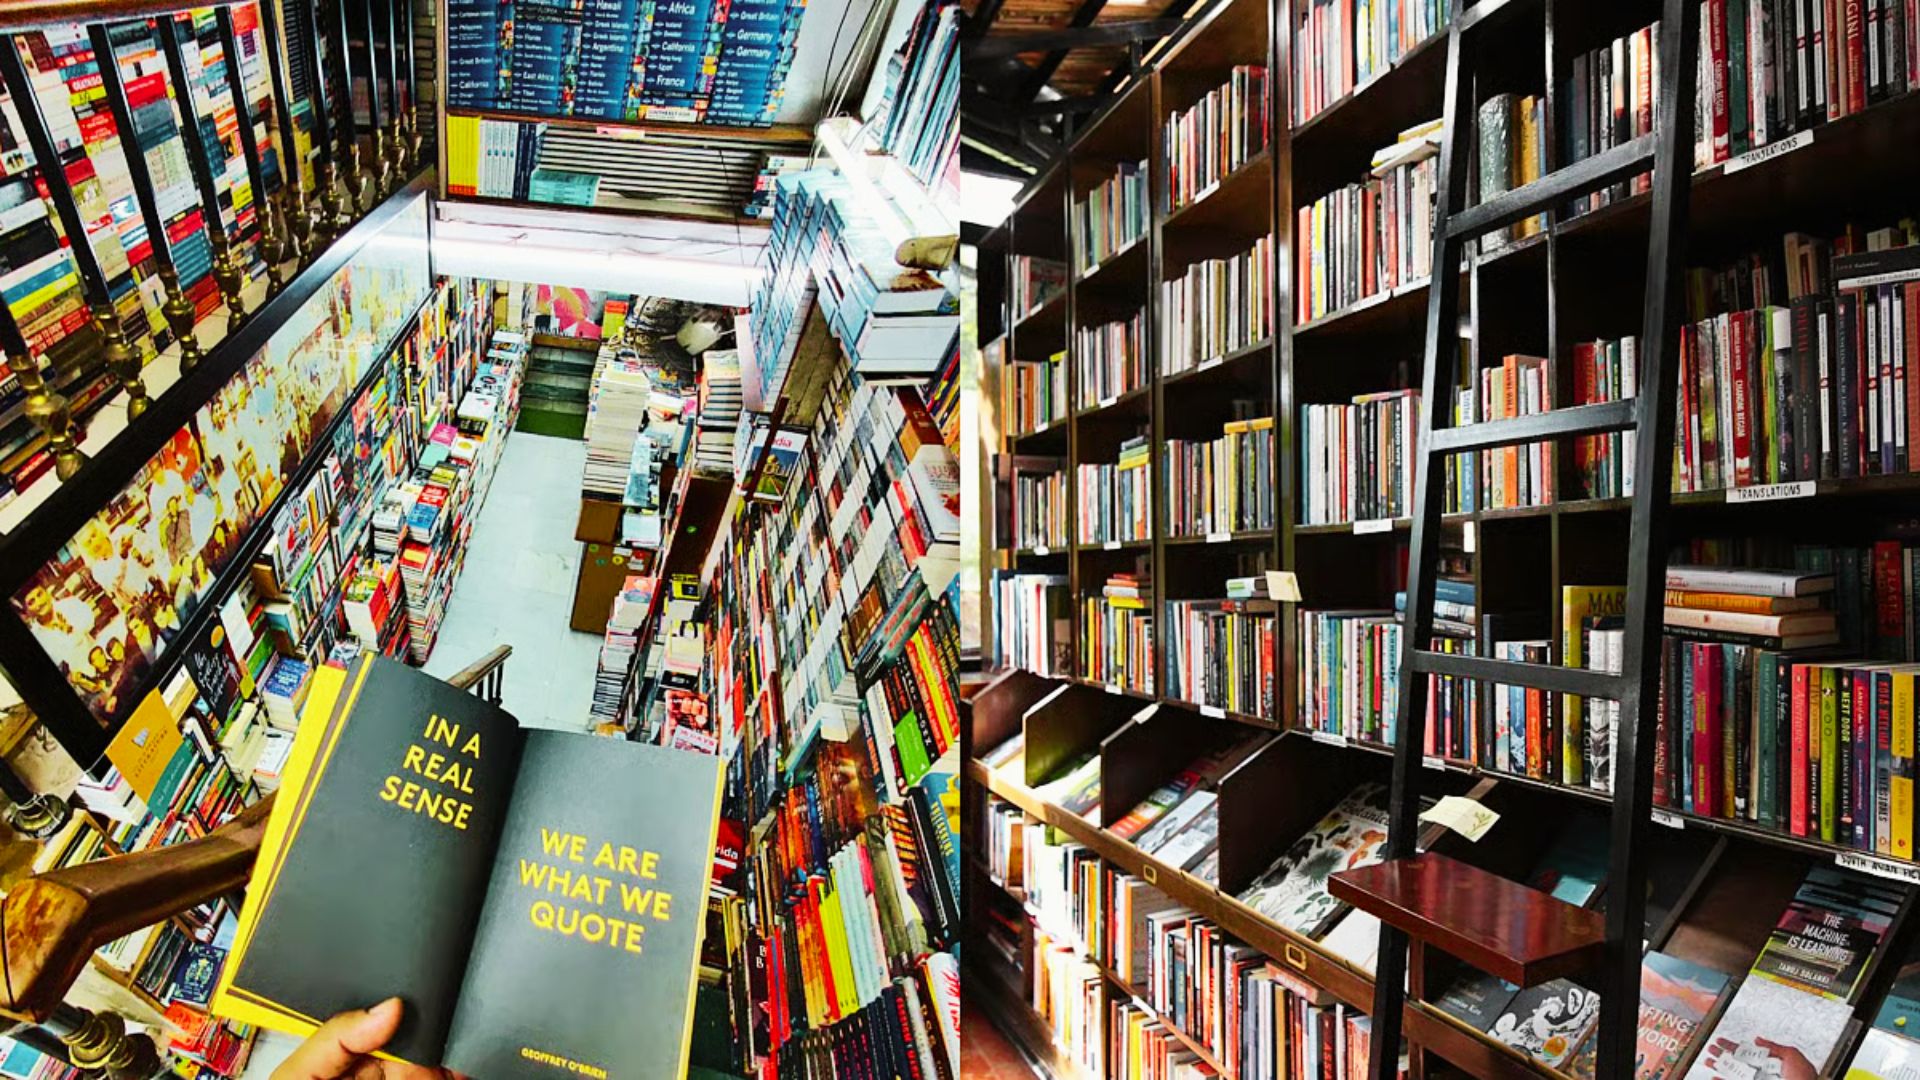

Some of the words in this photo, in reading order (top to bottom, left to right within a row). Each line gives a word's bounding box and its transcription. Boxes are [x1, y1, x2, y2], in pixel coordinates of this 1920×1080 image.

[596, 0, 622, 10] Hawaii
[668, 2, 697, 15] Africa
[740, 12, 758, 20] Great
[759, 12, 779, 21] Britain
[595, 21, 610, 29] Greek
[593, 32, 609, 40] Greek
[609, 33, 628, 42] Islands
[737, 28, 773, 43] Germany
[592, 42, 625, 53] Argentina
[661, 41, 697, 52] California
[736, 46, 772, 59] Germany
[458, 80, 489, 89] California
[537, 73, 554, 82] Africa
[656, 75, 686, 88] France
[584, 106, 604, 116] Brazil
[1737, 484, 1801, 500] TRANSLATIONS
[1886, 568, 1898, 624] PLASTIC
[1841, 691, 1850, 717] NEXT
[1794, 689, 1805, 743] Aftertaste
[423, 714, 460, 748] IN
[461, 733, 481, 759] A
[1841, 718, 1850, 743] DOOR
[403, 744, 474, 794] REAL
[379, 775, 473, 830] SENSE
[540, 828, 587, 862] WE
[593, 842, 660, 880] ARE
[519, 859, 612, 906] WHAT
[620, 883, 672, 921] WE
[530, 901, 645, 953] QUOTE
[1823, 912, 1844, 929] THE
[1802, 924, 1850, 944] MACHINE
[1787, 935, 1800, 948] IS
[1799, 940, 1848, 961] LEARNING
[521, 1047, 568, 1068] GEOFFREY
[568, 1060, 607, 1080] O'BRIEN
